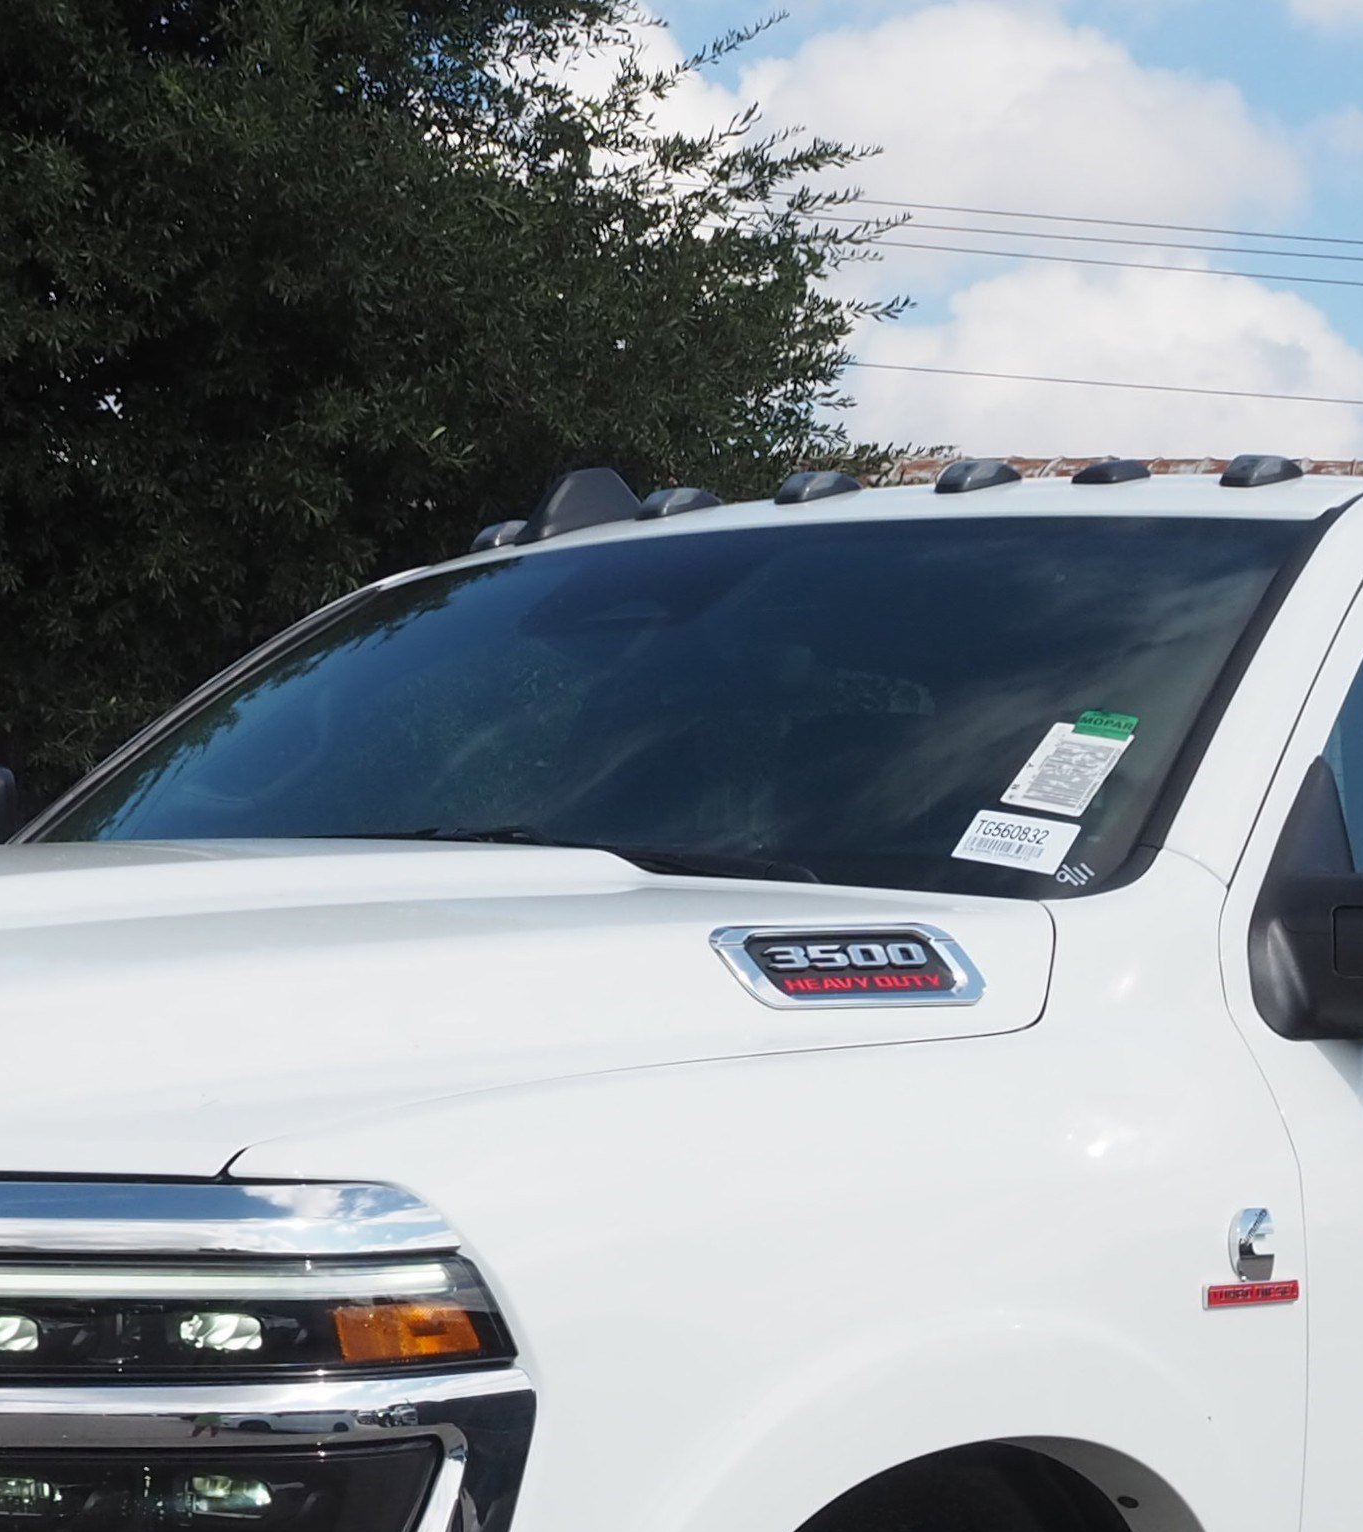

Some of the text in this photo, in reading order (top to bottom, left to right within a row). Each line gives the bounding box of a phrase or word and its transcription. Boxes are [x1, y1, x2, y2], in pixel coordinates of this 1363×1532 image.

[1079, 716, 1134, 731] MOPAR
[975, 819, 1050, 846] TG560832
[763, 942, 928, 972] 3500
[784, 973, 941, 993] HEAVY DUTY
